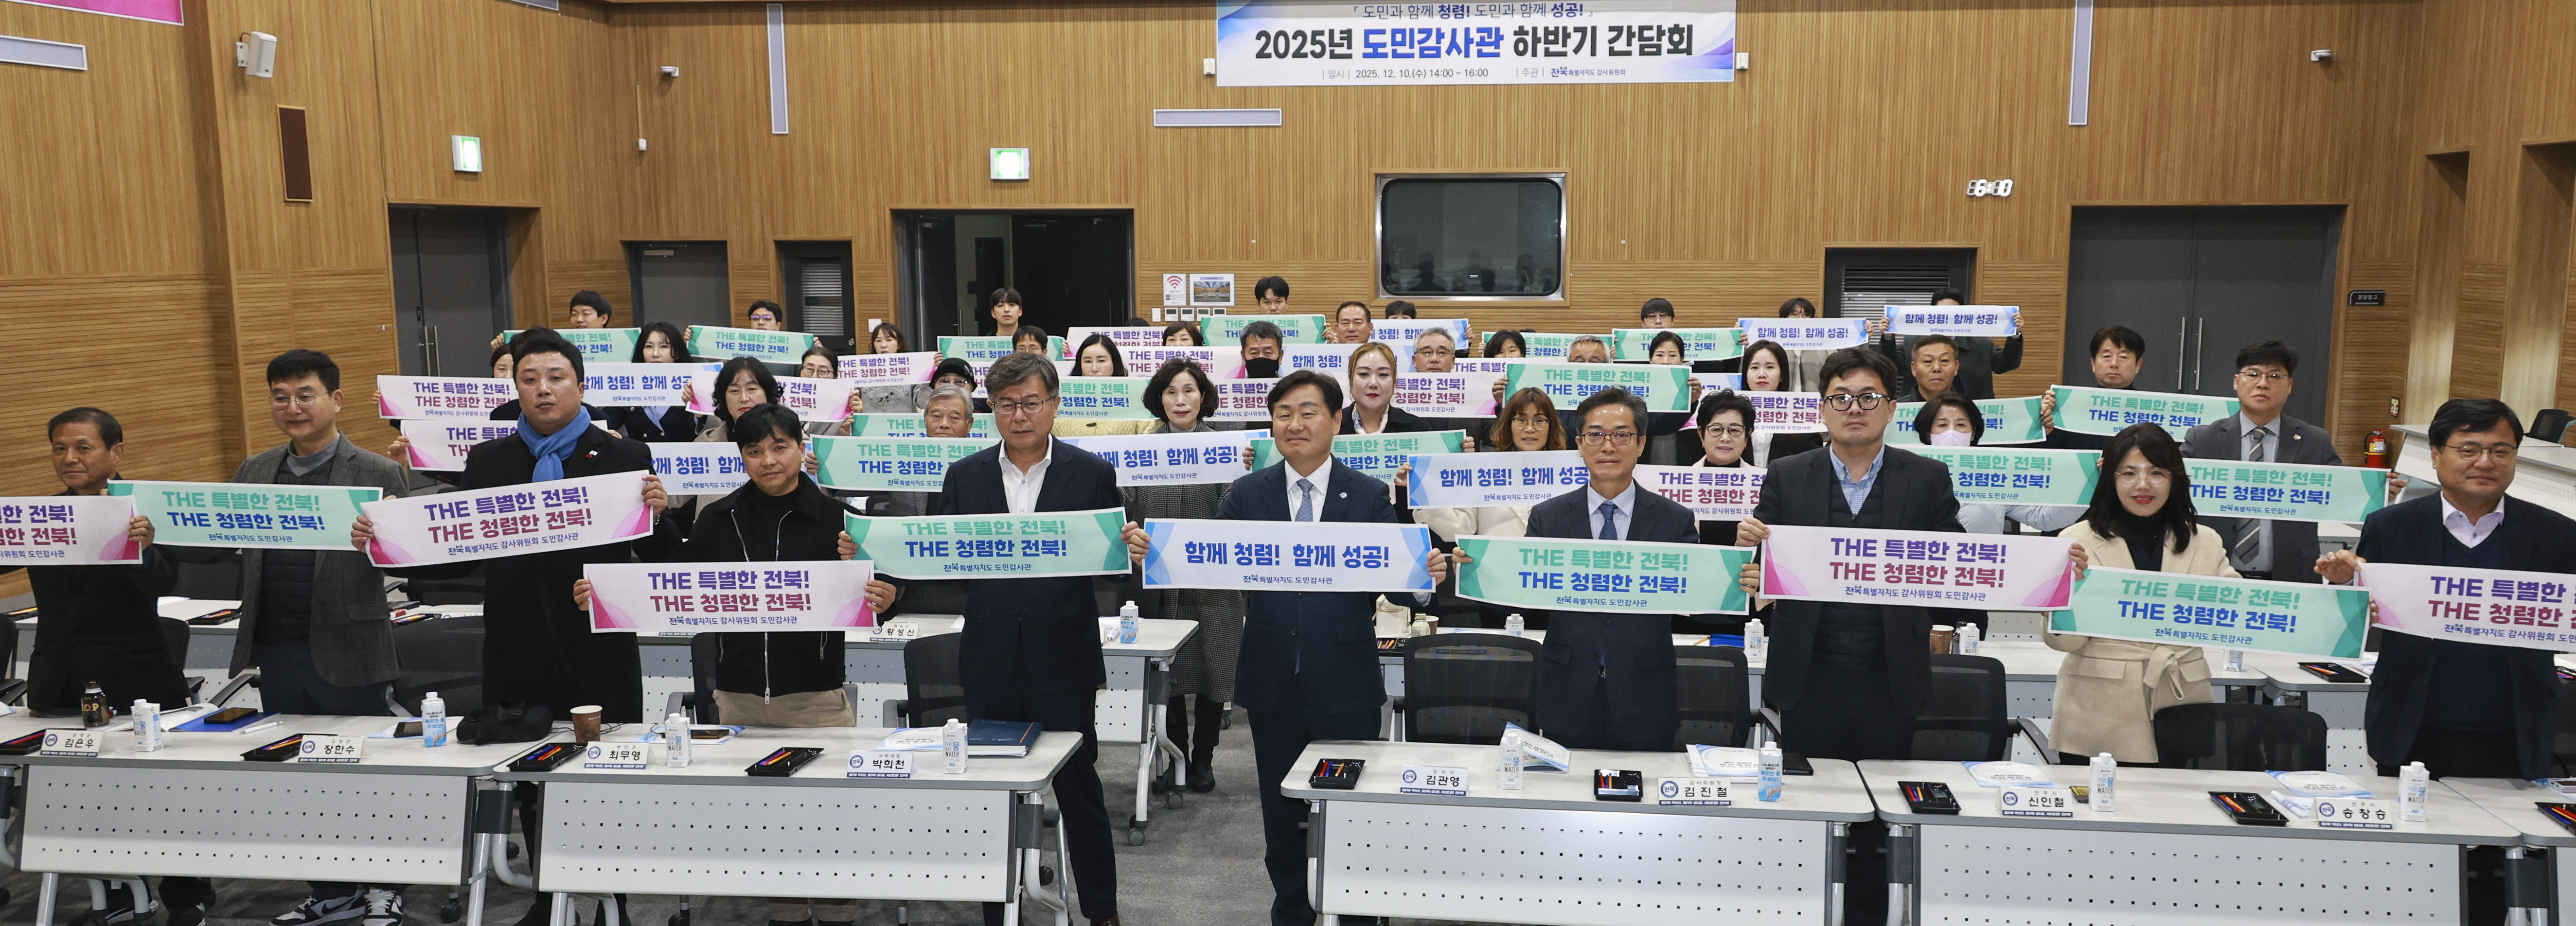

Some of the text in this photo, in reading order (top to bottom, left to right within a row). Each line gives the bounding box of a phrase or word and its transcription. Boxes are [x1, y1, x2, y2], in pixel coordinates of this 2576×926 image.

[1363, 4, 1583, 19] 도민과 함께 청렴! 도민과 함께 성공!
[1255, 24, 1693, 59] 2025년 도민감사관 하반기 간담회
[1328, 70, 1344, 79] 일시
[1356, 70, 1379, 78] 2025.
[1383, 70, 1396, 78] 12.
[1400, 69, 1426, 79] 10.(수)
[1430, 69, 1453, 78] 14:00
[1465, 69, 1488, 78] 16:00
[1522, 68, 1538, 77] 주관
[1905, 314, 1997, 324] 함께 청렴! 함께 성공!
[1758, 327, 1848, 338] 함께 청렴! 함께 성공!
[715, 341, 789, 353] THE 청렴한 전북!
[1124, 446, 1237, 467] 청렴! 함께 성공!
[1440, 467, 1588, 487] 함께 청렴! 함께 성공
[2191, 467, 2332, 487] THE 특별한 전북!
[162, 492, 320, 511] THE 특별한 전북!
[424, 487, 588, 521] THE 특별한 전북!
[2190, 485, 2329, 505] THE 청렴한 전북!
[29, 506, 73, 523] 전북!
[167, 512, 324, 530] THE 청렴한 전북!
[428, 508, 592, 543] THE 청렴한 전북!
[902, 520, 1066, 536] THE 특별한 전북!
[32, 528, 76, 545] 전북!
[209, 532, 255, 542] 전북특별자치도
[447, 533, 579, 556] 전북특별자치도 감사위원회 도민감사관
[905, 540, 1066, 558] THE 청렴한 전북!
[1185, 541, 1388, 569] 함께 청렴! 함께 성공!
[1831, 538, 2006, 564] THE 특별한 전북!
[943, 563, 993, 572] 전북특별자치도
[1519, 548, 1688, 572] THE 특별한 전북!
[648, 571, 809, 590] THE 특별한 전북!
[1243, 575, 1332, 585] 전북특별자치도 도민감사관
[1519, 572, 1687, 594] THE 청렴한 전북!
[1830, 562, 2004, 588] THE 청렴한 전북!
[1845, 585, 1986, 601] 전북특별자치도 감사위원회 도민감사관
[2121, 580, 2300, 610] THE 특별한 전북!
[2431, 577, 2566, 603] THE 특별한
[650, 594, 811, 613] THE 청렴한 전북!
[1556, 596, 1647, 607] 전북특별자치도 도민감사관
[669, 616, 797, 626] 전북특별자치도 감사위원회 도민감사관
[2117, 601, 2296, 633] THE 청렴한 전북!
[2429, 600, 2562, 627] THE 청렴한
[2155, 628, 2253, 645] 전북특별자치도 도민감사관
[2444, 624, 2505, 637] 전북특별자치도
[2508, 630, 2555, 642] 감사위원회
[324, 745, 354, 754] 장한수
[609, 751, 640, 761] 최무영
[873, 760, 904, 769] 박희천
[1427, 776, 1459, 786] 김관영
[1685, 787, 1727, 797] 김진철
[2029, 797, 2064, 807] 신인철
[2343, 808, 2385, 820] 송창승
